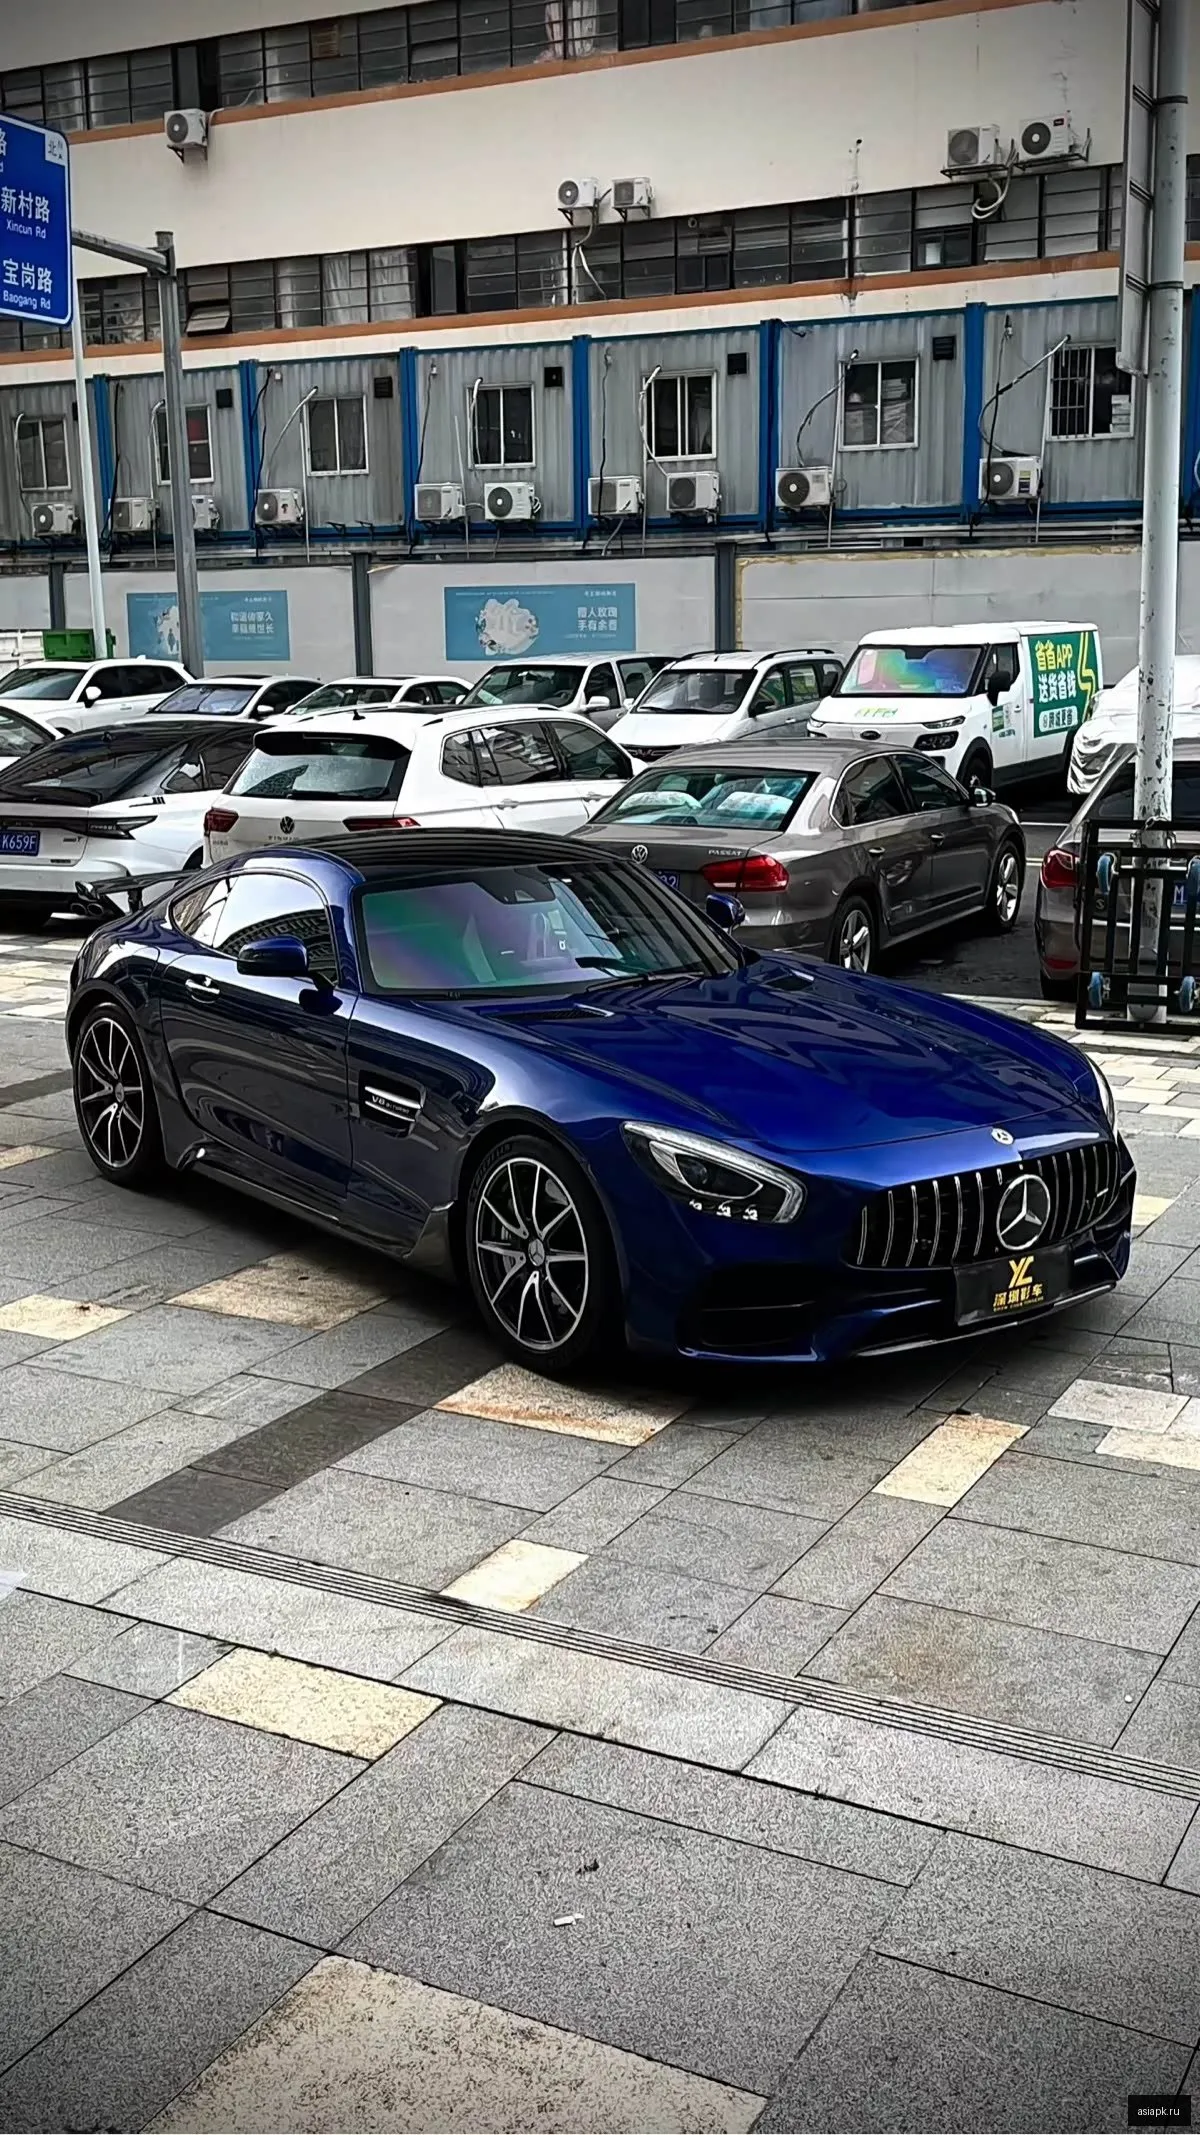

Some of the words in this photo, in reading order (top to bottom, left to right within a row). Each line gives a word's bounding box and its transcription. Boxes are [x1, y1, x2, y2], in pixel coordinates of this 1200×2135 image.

[1, 186, 50, 223] 新村路
[6, 219, 33, 236] Xincun
[36, 224, 46, 239] Rd
[3, 258, 53, 294] 宝岗路
[3, 290, 37, 310] Baogang
[40, 297, 51, 310] Rd
[1038, 670, 1077, 703] 送货省钱
[2, 834, 37, 850] K659F
